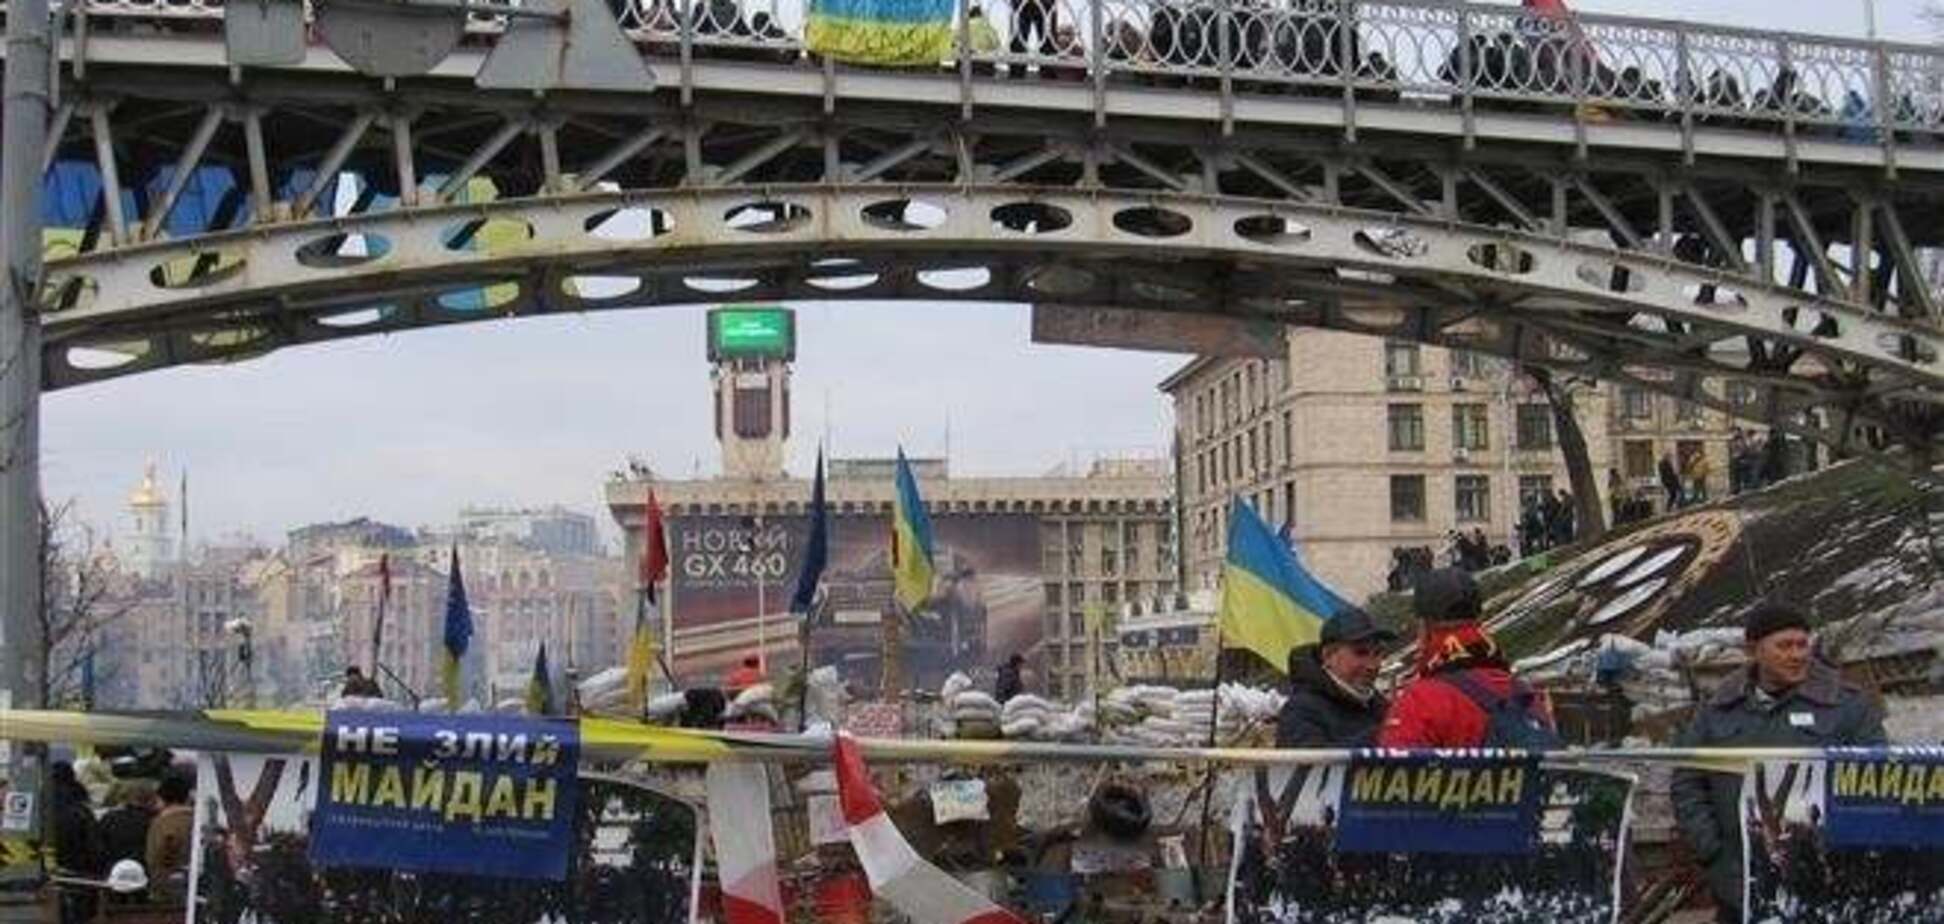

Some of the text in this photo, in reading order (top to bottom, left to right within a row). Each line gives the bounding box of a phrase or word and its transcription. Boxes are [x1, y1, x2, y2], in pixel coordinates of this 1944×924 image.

[684, 551, 786, 578] GX 460
[337, 725, 560, 766] НЕ ЗЛИЙ
[330, 757, 558, 824] МАЙДАН
[1351, 760, 1524, 812] МАЙДАН
